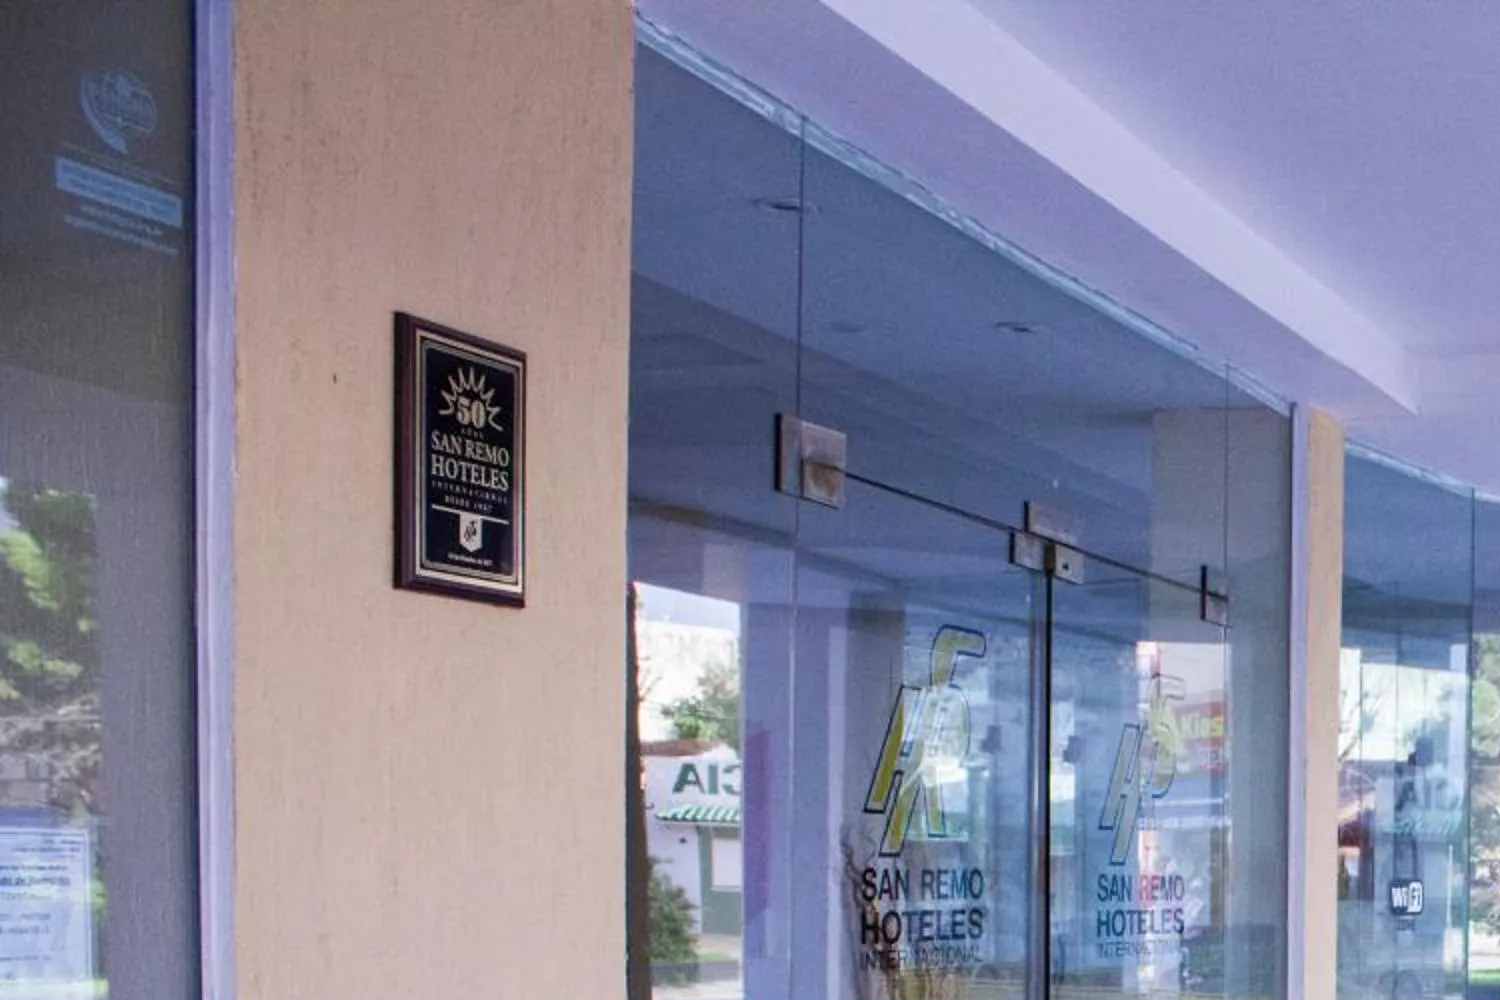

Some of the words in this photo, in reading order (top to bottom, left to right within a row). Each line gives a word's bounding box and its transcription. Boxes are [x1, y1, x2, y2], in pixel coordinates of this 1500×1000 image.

[456, 396, 485, 429] 50
[431, 429, 461, 455] SAN
[465, 440, 509, 467] REMO
[431, 454, 509, 491] HOTELES
[862, 867, 910, 901] SAN
[921, 867, 984, 900] REMO
[1097, 873, 1133, 902] SAN
[1140, 875, 1185, 901] REMO
[861, 908, 985, 944] HOTELES
[1096, 908, 1185, 938] HOTELES
